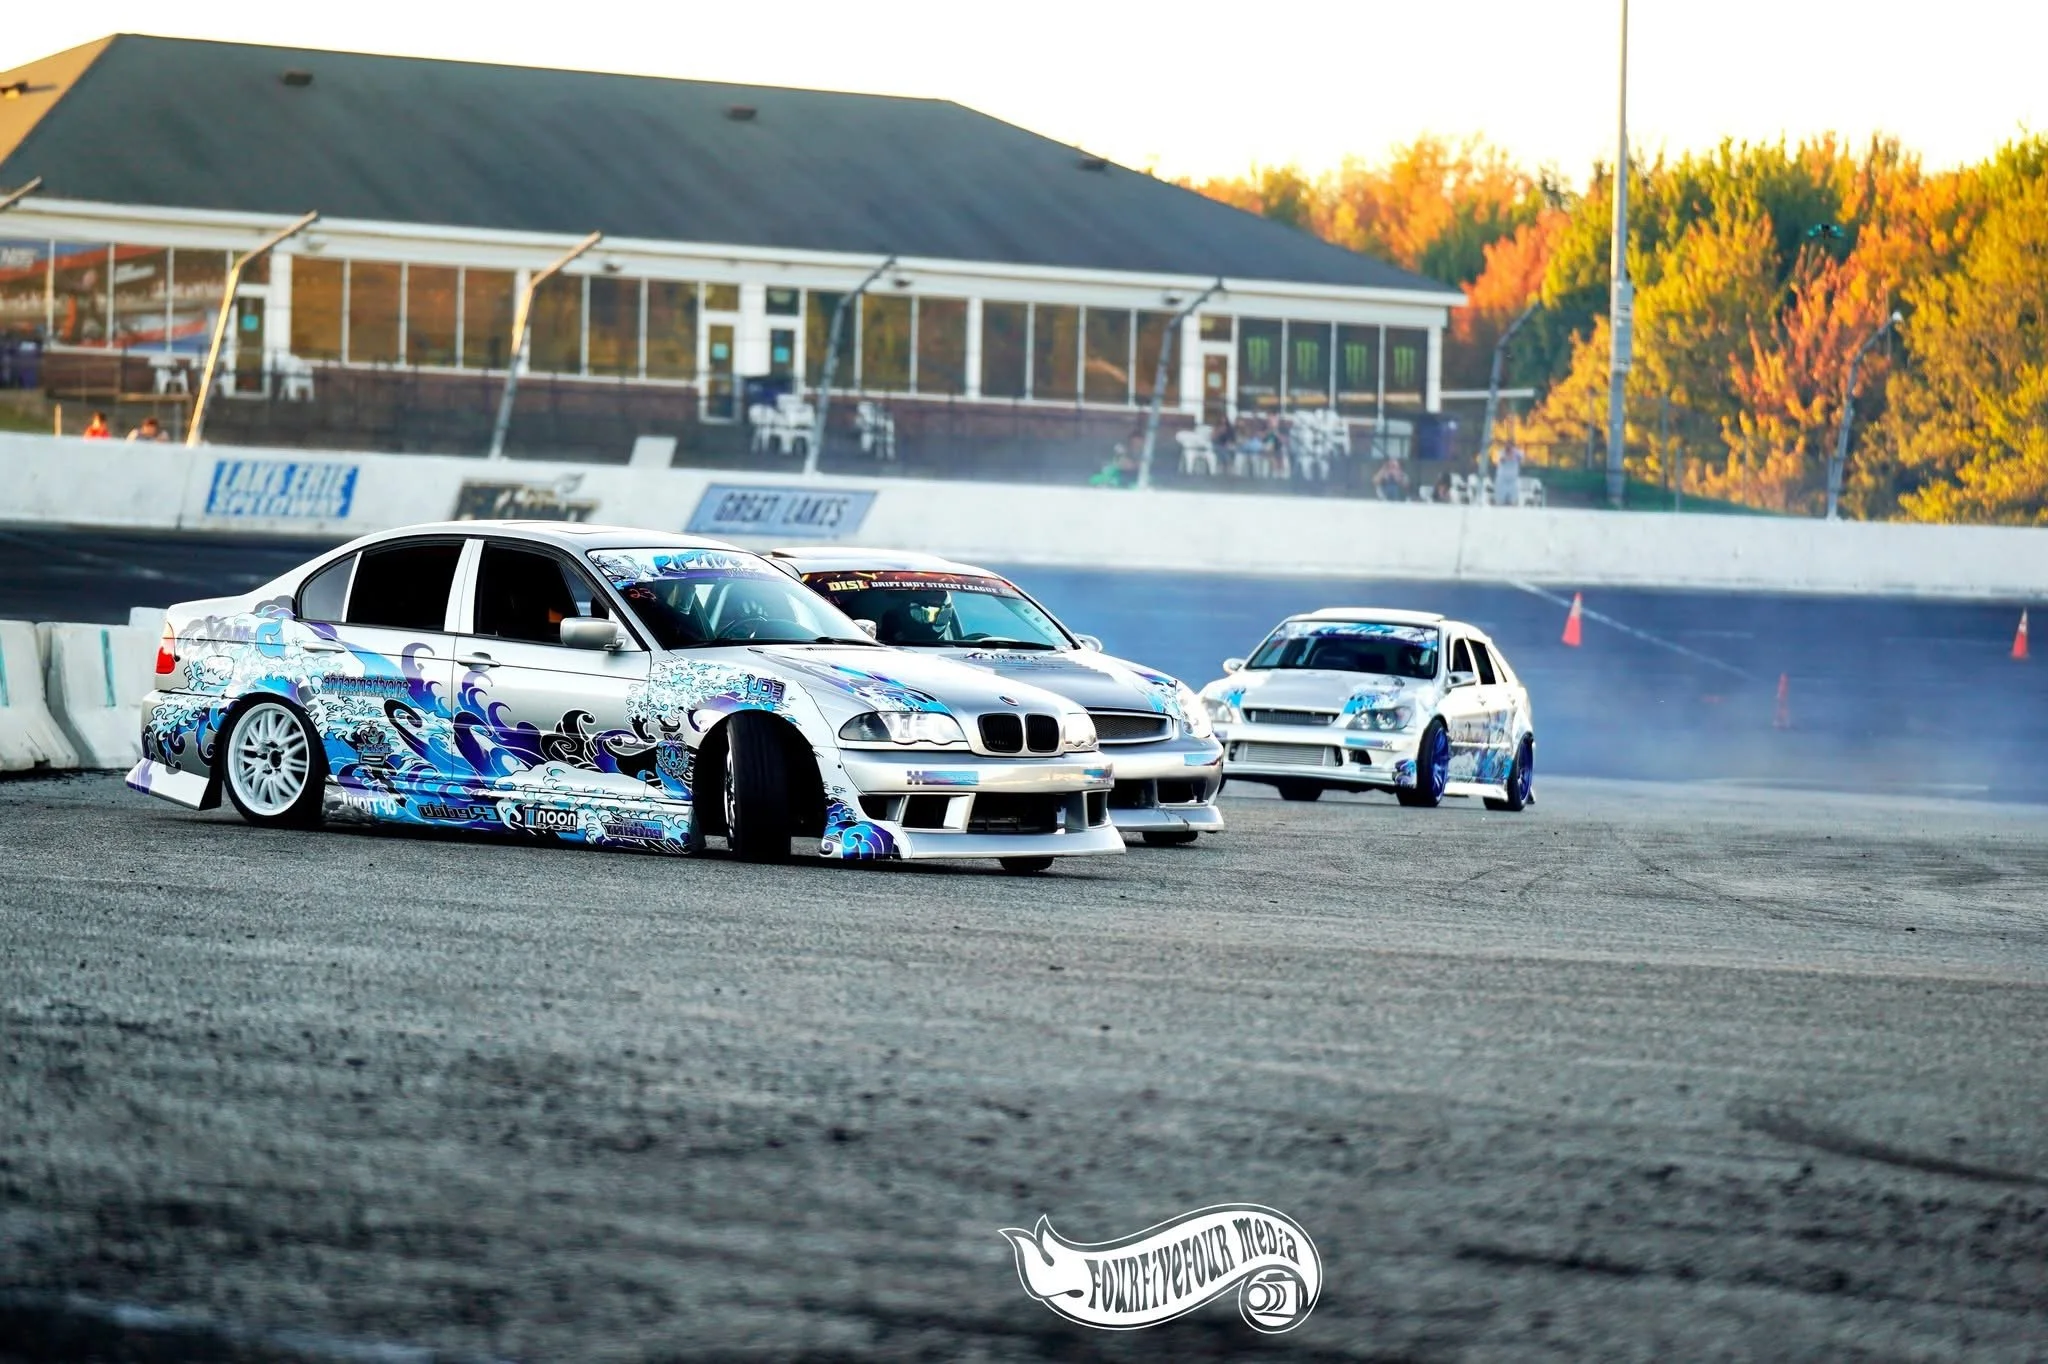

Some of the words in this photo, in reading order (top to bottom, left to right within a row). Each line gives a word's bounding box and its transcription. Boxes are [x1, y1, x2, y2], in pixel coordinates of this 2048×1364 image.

[827, 579, 870, 592] DISL
[870, 581, 900, 589] DRIFT
[926, 582, 961, 590] STREET
[962, 584, 999, 593] LEAGUE
